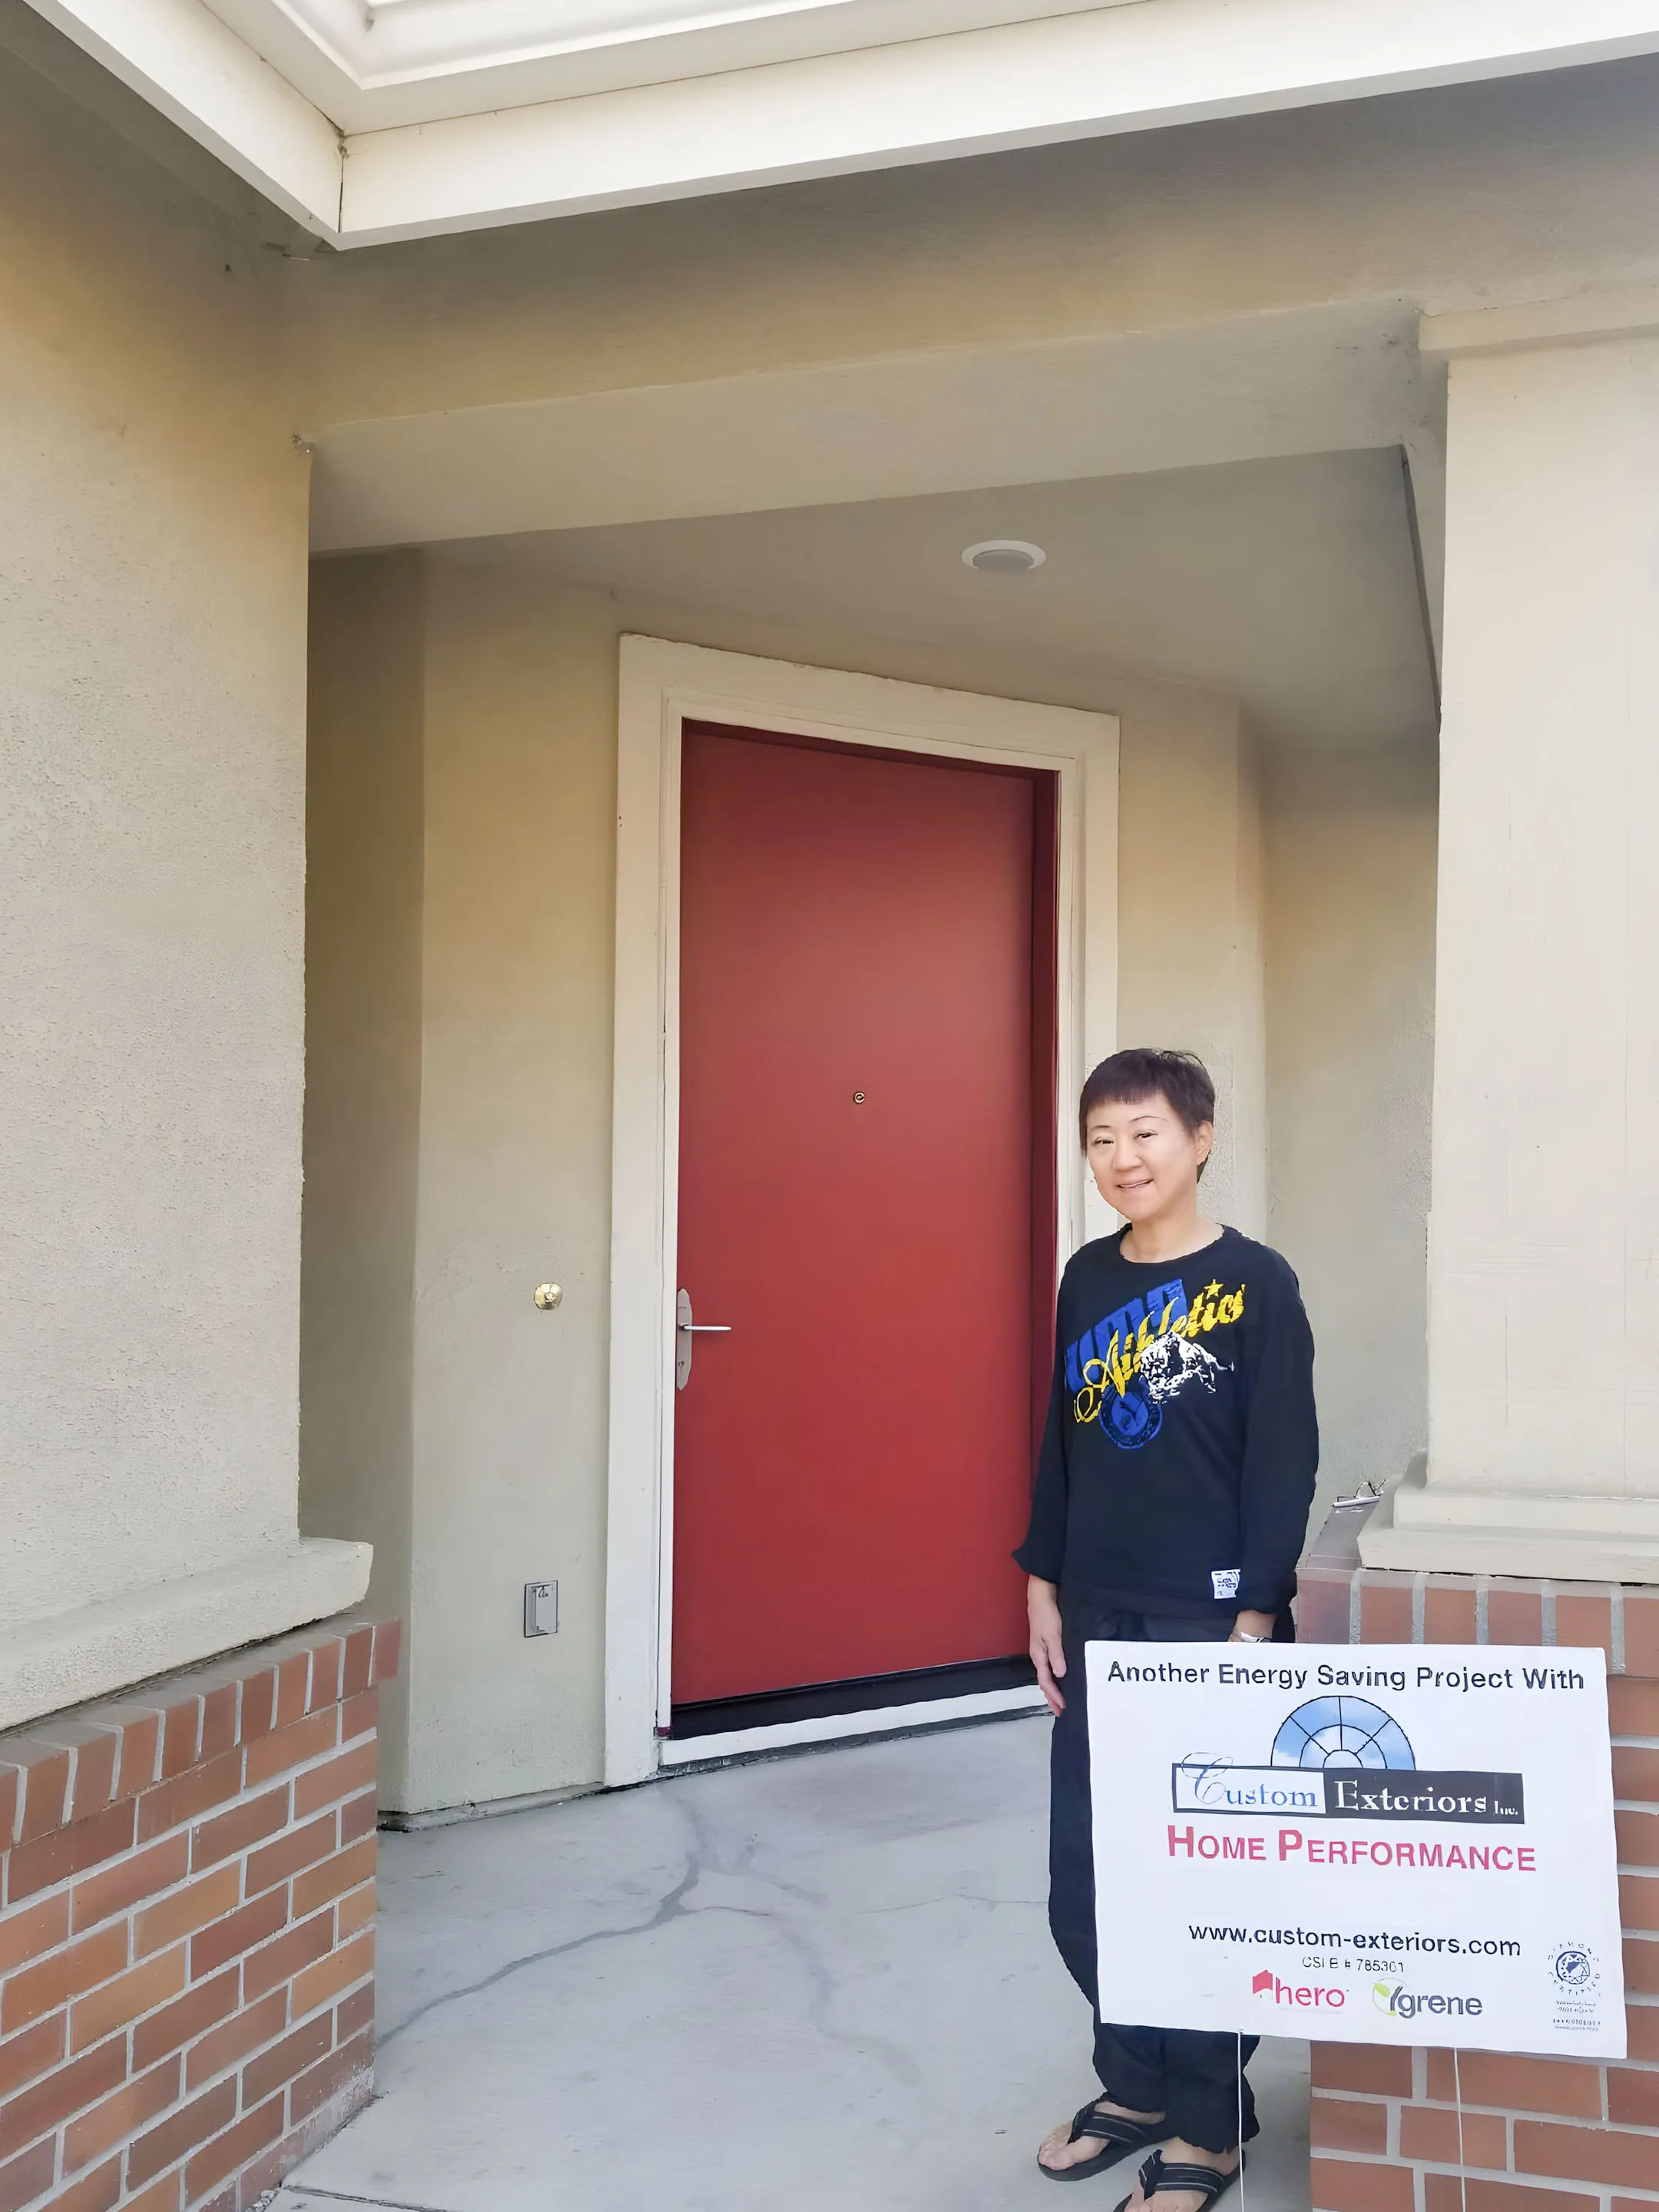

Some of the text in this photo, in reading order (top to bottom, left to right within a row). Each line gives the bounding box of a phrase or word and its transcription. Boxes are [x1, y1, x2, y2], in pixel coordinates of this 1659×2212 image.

[1108, 1661, 1584, 1693] Another Energy Saving Project With
[1181, 1752, 1319, 1807] Custom
[1333, 1780, 1487, 1814] Exteriors
[1167, 1824, 1537, 1872] HOME PERFORMANCE
[1188, 1925, 1521, 1957] www.custom-exteriors.com
[1275, 1976, 1346, 2008] hero
